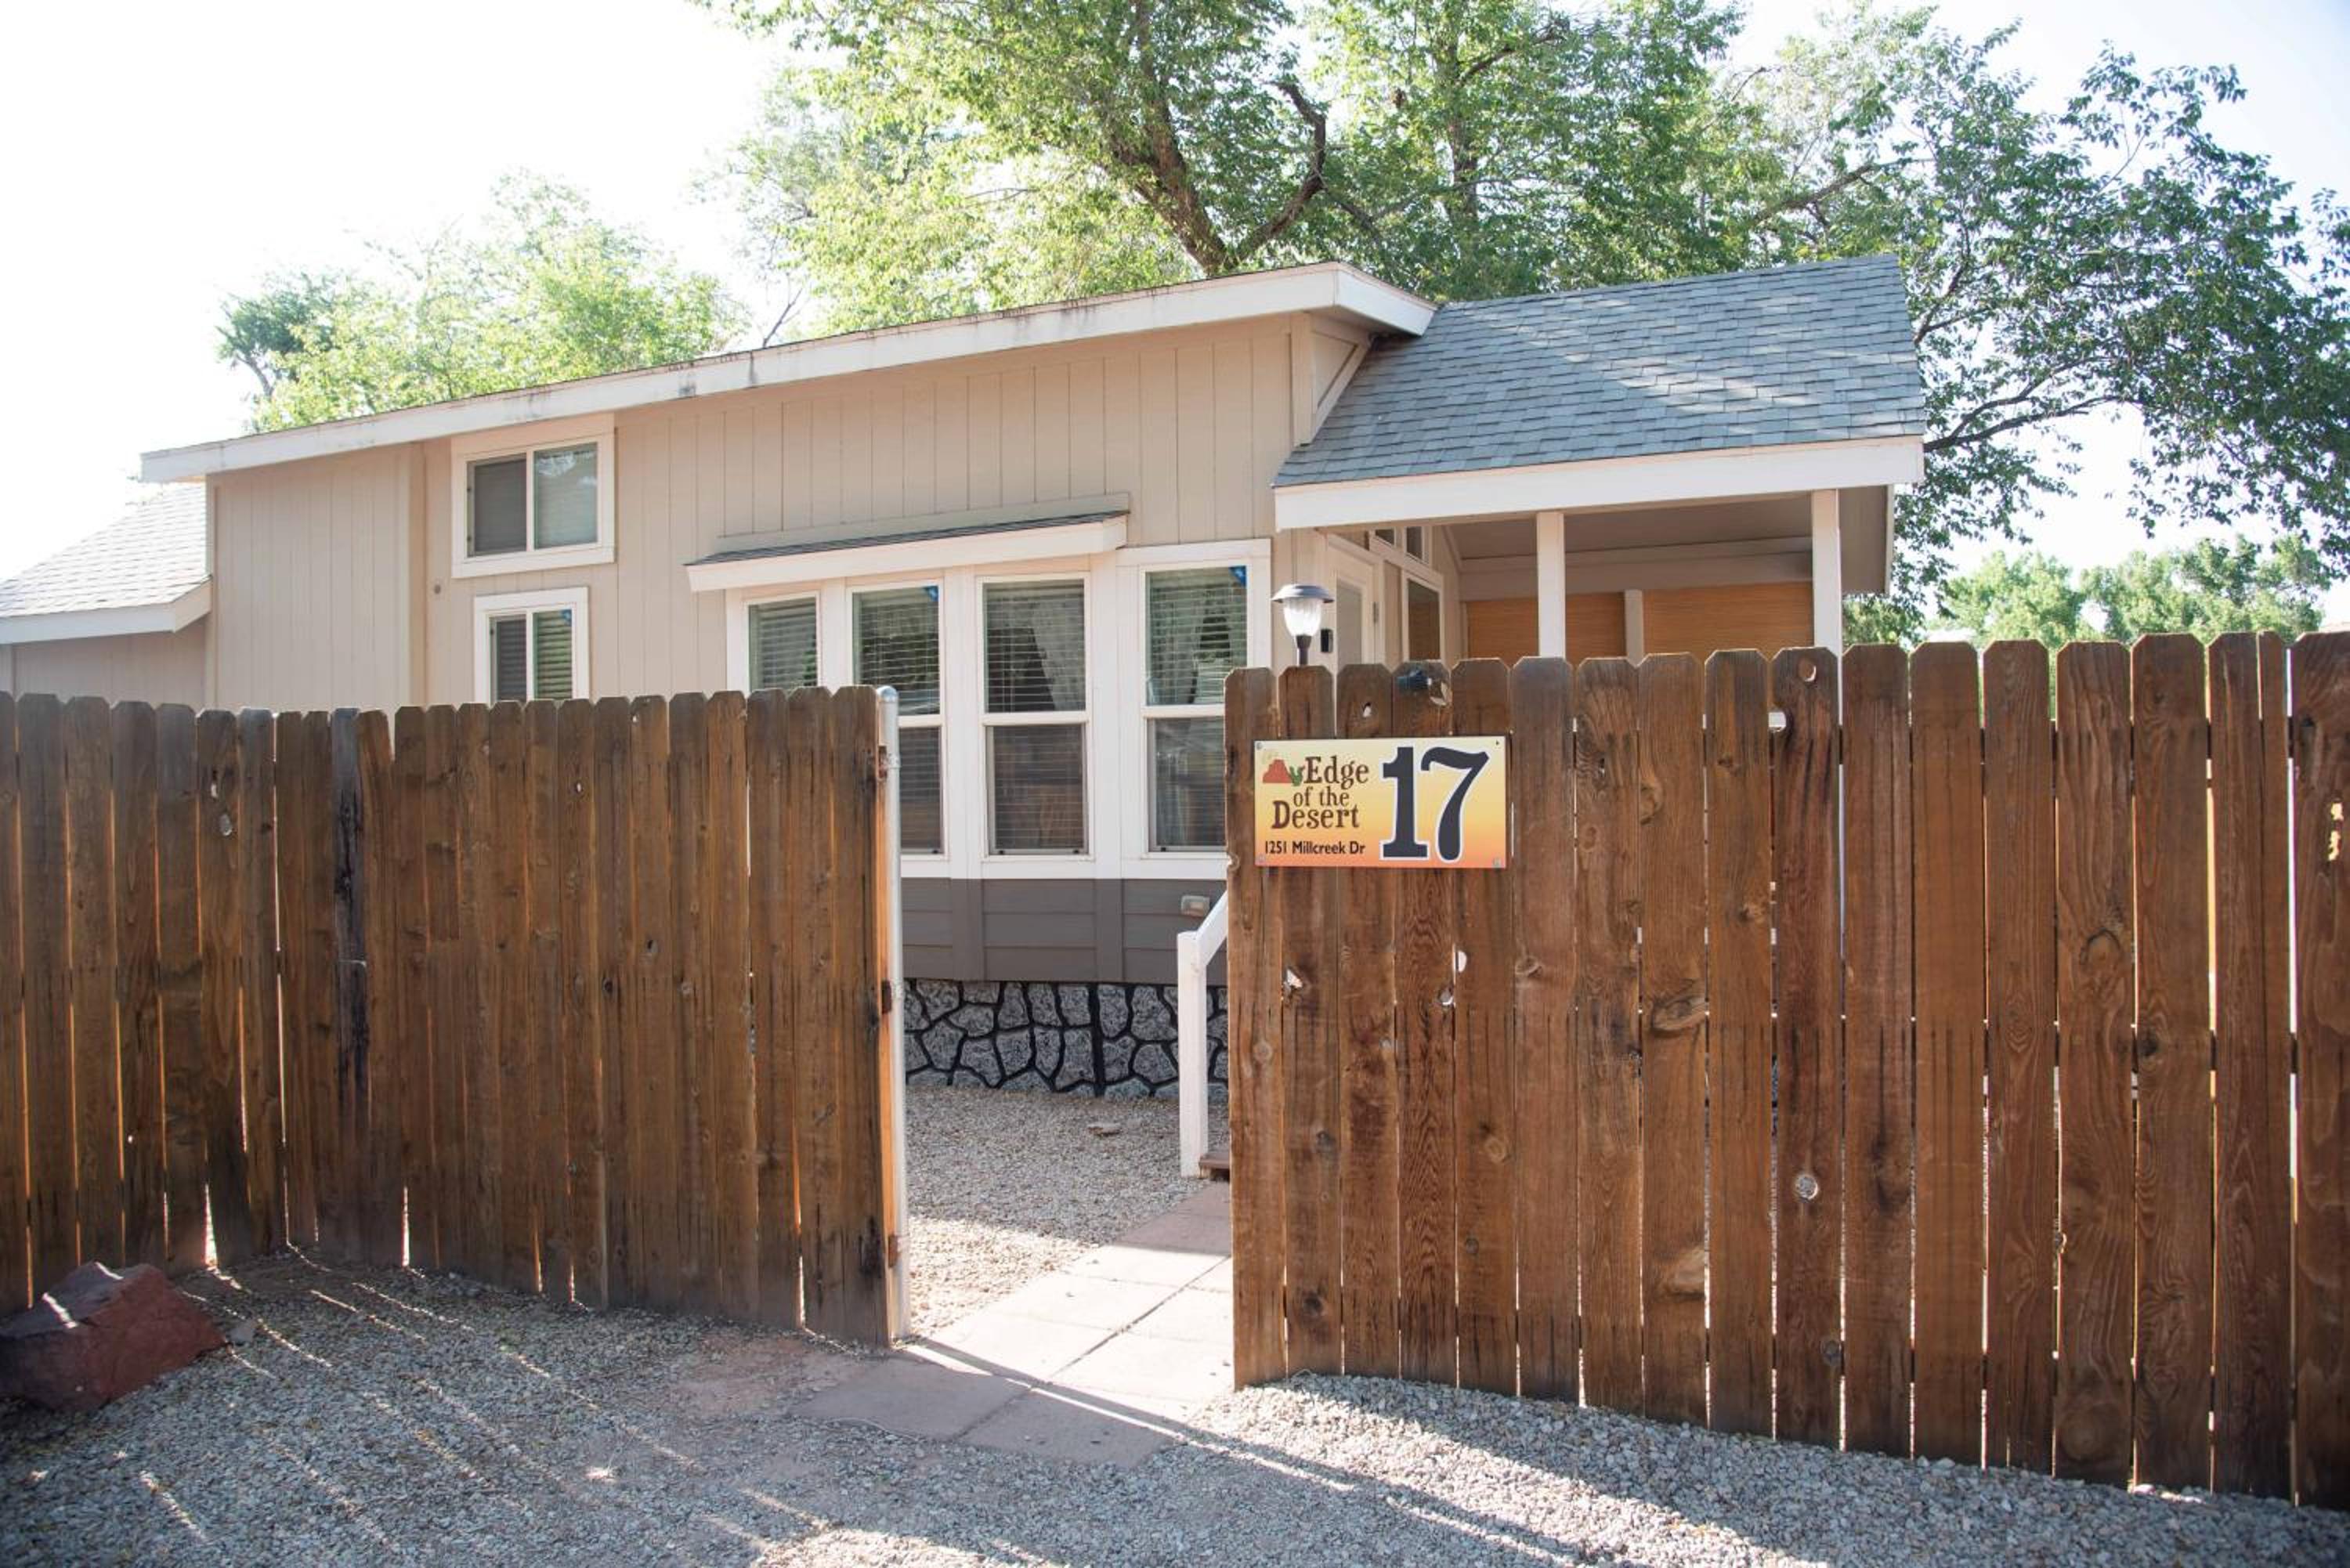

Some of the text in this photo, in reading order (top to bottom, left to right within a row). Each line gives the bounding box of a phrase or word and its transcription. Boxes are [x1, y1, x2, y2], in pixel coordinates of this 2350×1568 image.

[1303, 756, 1369, 789] Edge
[1293, 786, 1350, 807] of the
[1383, 746, 1490, 861] 17
[1271, 800, 1360, 829] Desert
[1264, 840, 1366, 854] 1251 Millcreek Dr
